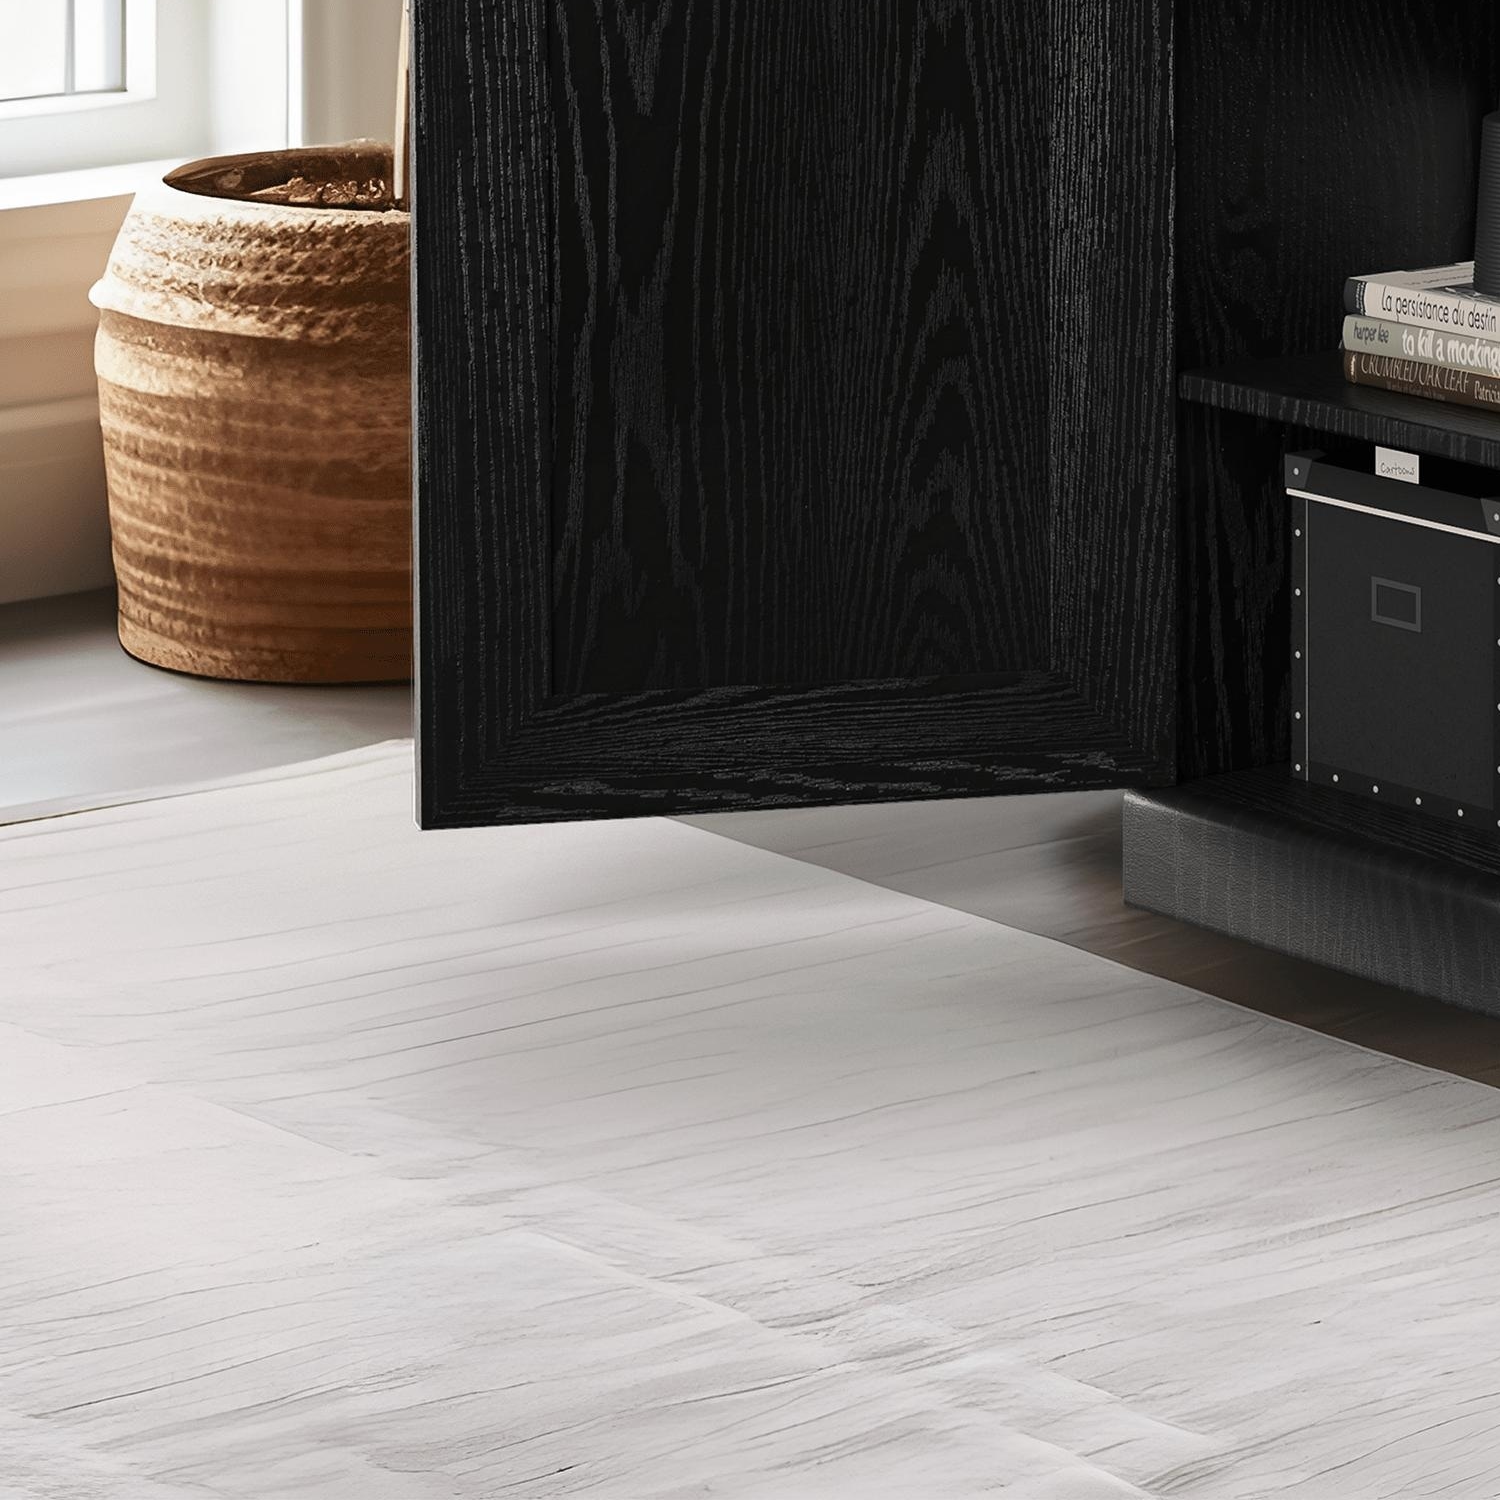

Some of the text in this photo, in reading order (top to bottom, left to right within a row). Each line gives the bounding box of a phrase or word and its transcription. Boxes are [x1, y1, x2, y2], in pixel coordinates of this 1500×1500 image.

[1381, 285, 1392, 312] La
[1395, 293, 1449, 322] persistance
[1452, 300, 1465, 327] du
[1467, 303, 1497, 332] destin
[1353, 322, 1389, 345] harper lee
[1402, 328, 1415, 356] to
[1417, 327, 1435, 358] kill
[1436, 337, 1445, 362] a
[1361, 355, 1418, 382] CRUMBLED
[1419, 363, 1441, 388] OAK
[1444, 366, 1469, 393] LEAF
[1474, 381, 1500, 404] Patricia
